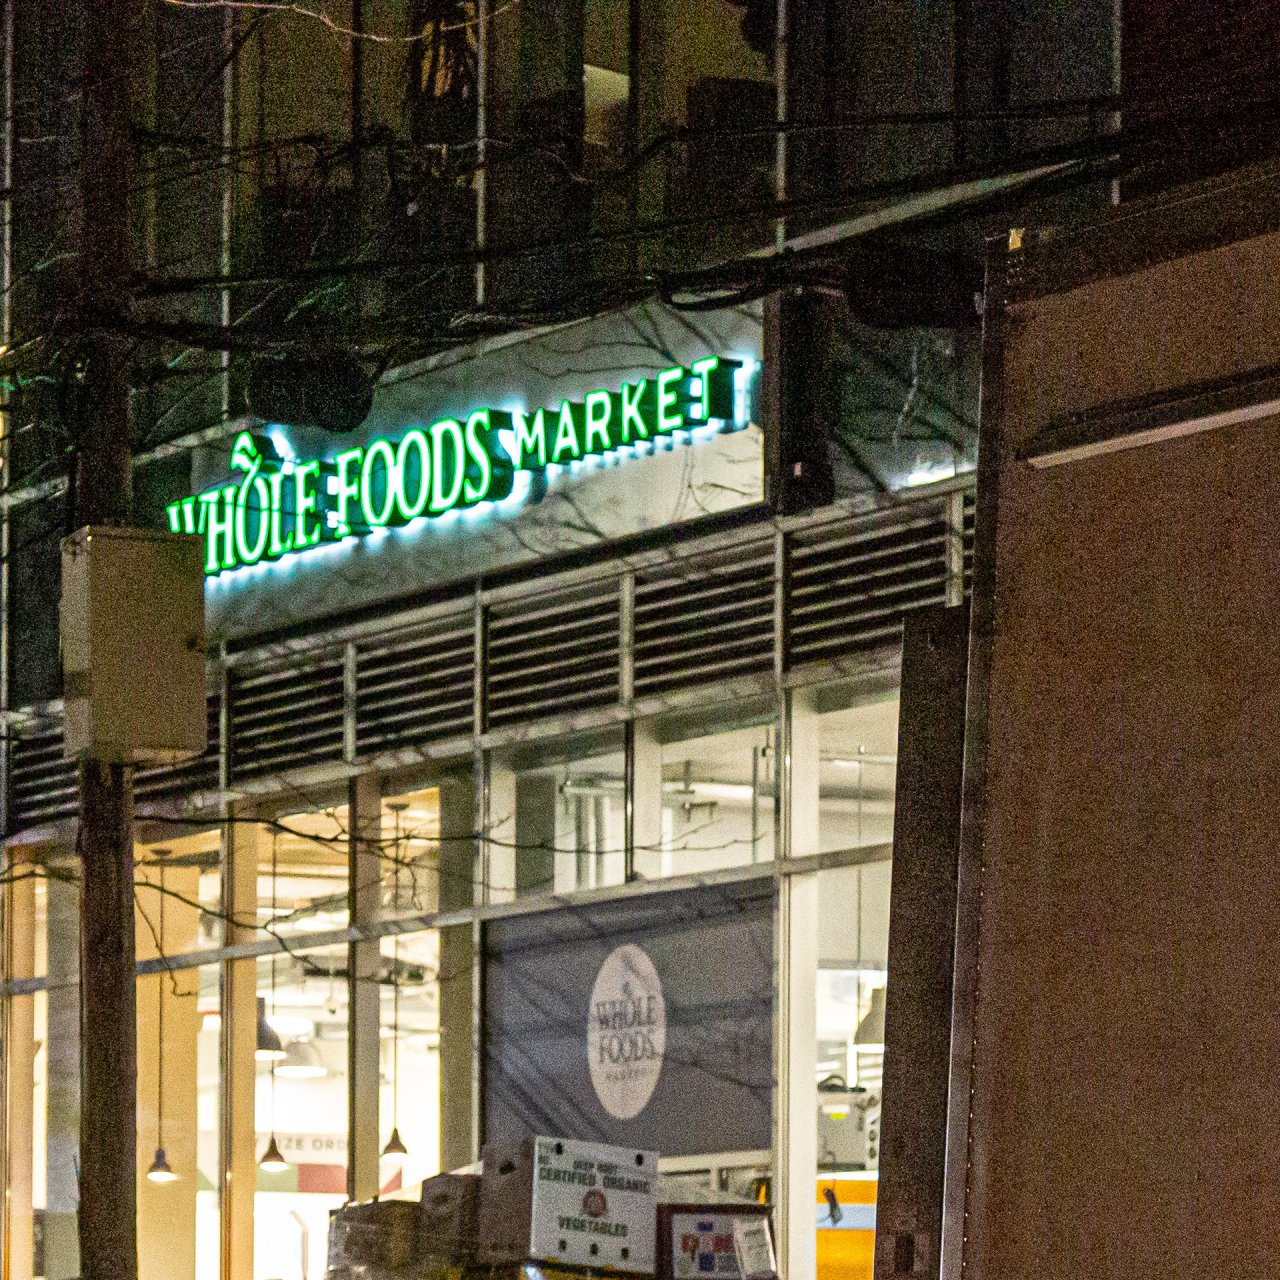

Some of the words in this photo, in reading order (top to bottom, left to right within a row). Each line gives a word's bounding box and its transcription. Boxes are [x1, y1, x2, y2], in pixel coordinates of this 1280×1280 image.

[336, 407, 493, 532] FOODS
[514, 355, 720, 469] MARKET
[596, 994, 657, 1031] WHOLE
[598, 1031, 658, 1065] FOODS
[538, 1167, 597, 1187] CERTIFIED
[603, 1175, 651, 1194] ORGANIC
[557, 1216, 628, 1238] VEGETABLES
